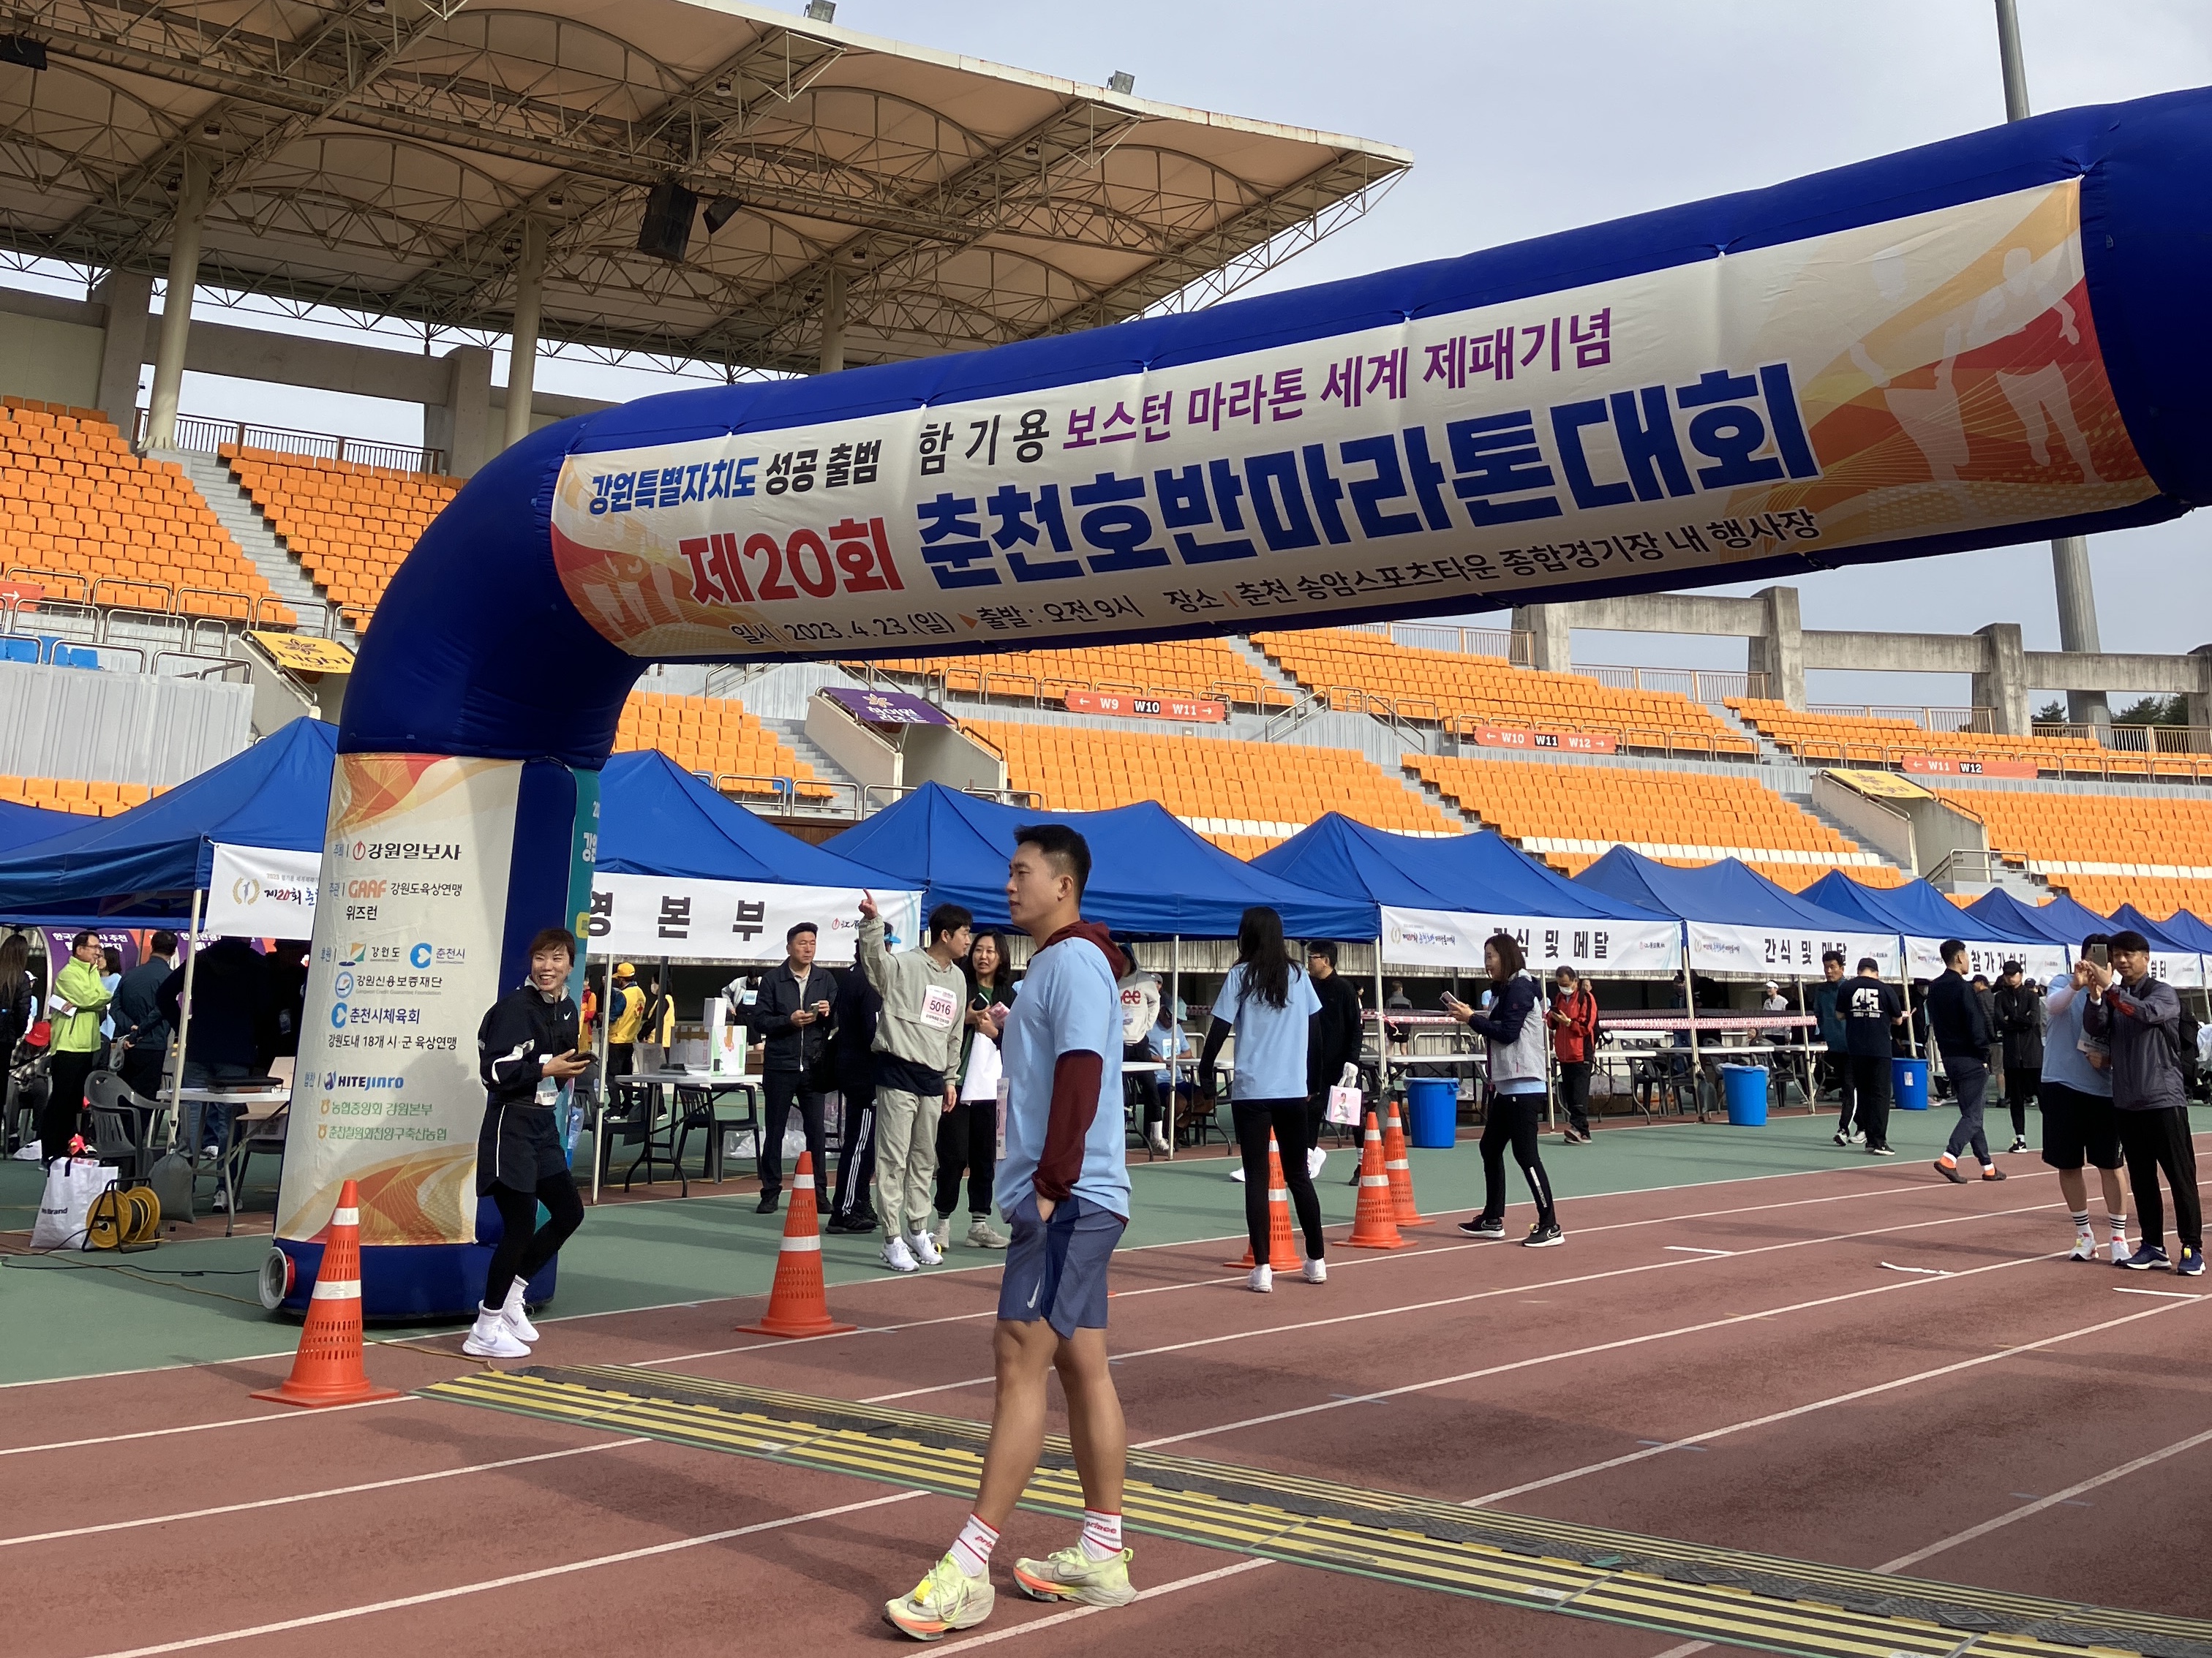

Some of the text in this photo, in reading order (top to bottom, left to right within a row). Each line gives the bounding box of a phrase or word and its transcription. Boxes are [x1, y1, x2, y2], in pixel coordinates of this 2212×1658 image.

[590, 456, 759, 515] 강원특별자치도
[765, 448, 818, 495] 성공
[825, 440, 882, 488] 출범
[1063, 391, 1173, 449] 보스턴
[1187, 367, 1306, 432] 마라톤
[1320, 347, 1408, 407] 세계
[1423, 307, 1611, 388] 제패기념
[679, 363, 1819, 603] 제20회 춘천호반마라톤대회
[731, 623, 778, 646] 일시
[1043, 595, 1144, 623] 오전9시
[1163, 589, 1224, 613] 장소
[1236, 579, 1297, 606] 춘천
[1296, 554, 1500, 600] 송암스포츠타운
[1500, 532, 1666, 576] 종합경기장
[1669, 525, 1710, 553] 내
[1705, 509, 1820, 549] 행사장
[1100, 698, 1197, 715] W9 W10 W11
[1502, 734, 1591, 749] W10 W11 W12
[1928, 761, 1982, 774] W11 W12
[368, 843, 462, 861] 강원일보사
[348, 880, 387, 899] GAAF
[391, 882, 463, 897] 강원도육상연맹
[346, 905, 378, 921] 위즈런
[372, 946, 400, 958] 강원도
[436, 948, 465, 960] 춘천시
[1546, 930, 1559, 958] 및
[1574, 931, 1609, 959] 메달
[1765, 939, 1791, 965] 간식
[1802, 941, 1812, 965] 및
[357, 975, 443, 988] 강원신용보증재단
[1120, 990, 1141, 1004] ee
[350, 1008, 420, 1025] 춘천시체육회
[930, 1001, 951, 1015] 5016
[328, 1034, 359, 1048] 강원도내
[363, 1035, 384, 1048] 18개
[415, 1036, 457, 1051] 육상연맹
[332, 1101, 432, 1116] 농협중앙회 강원본부
